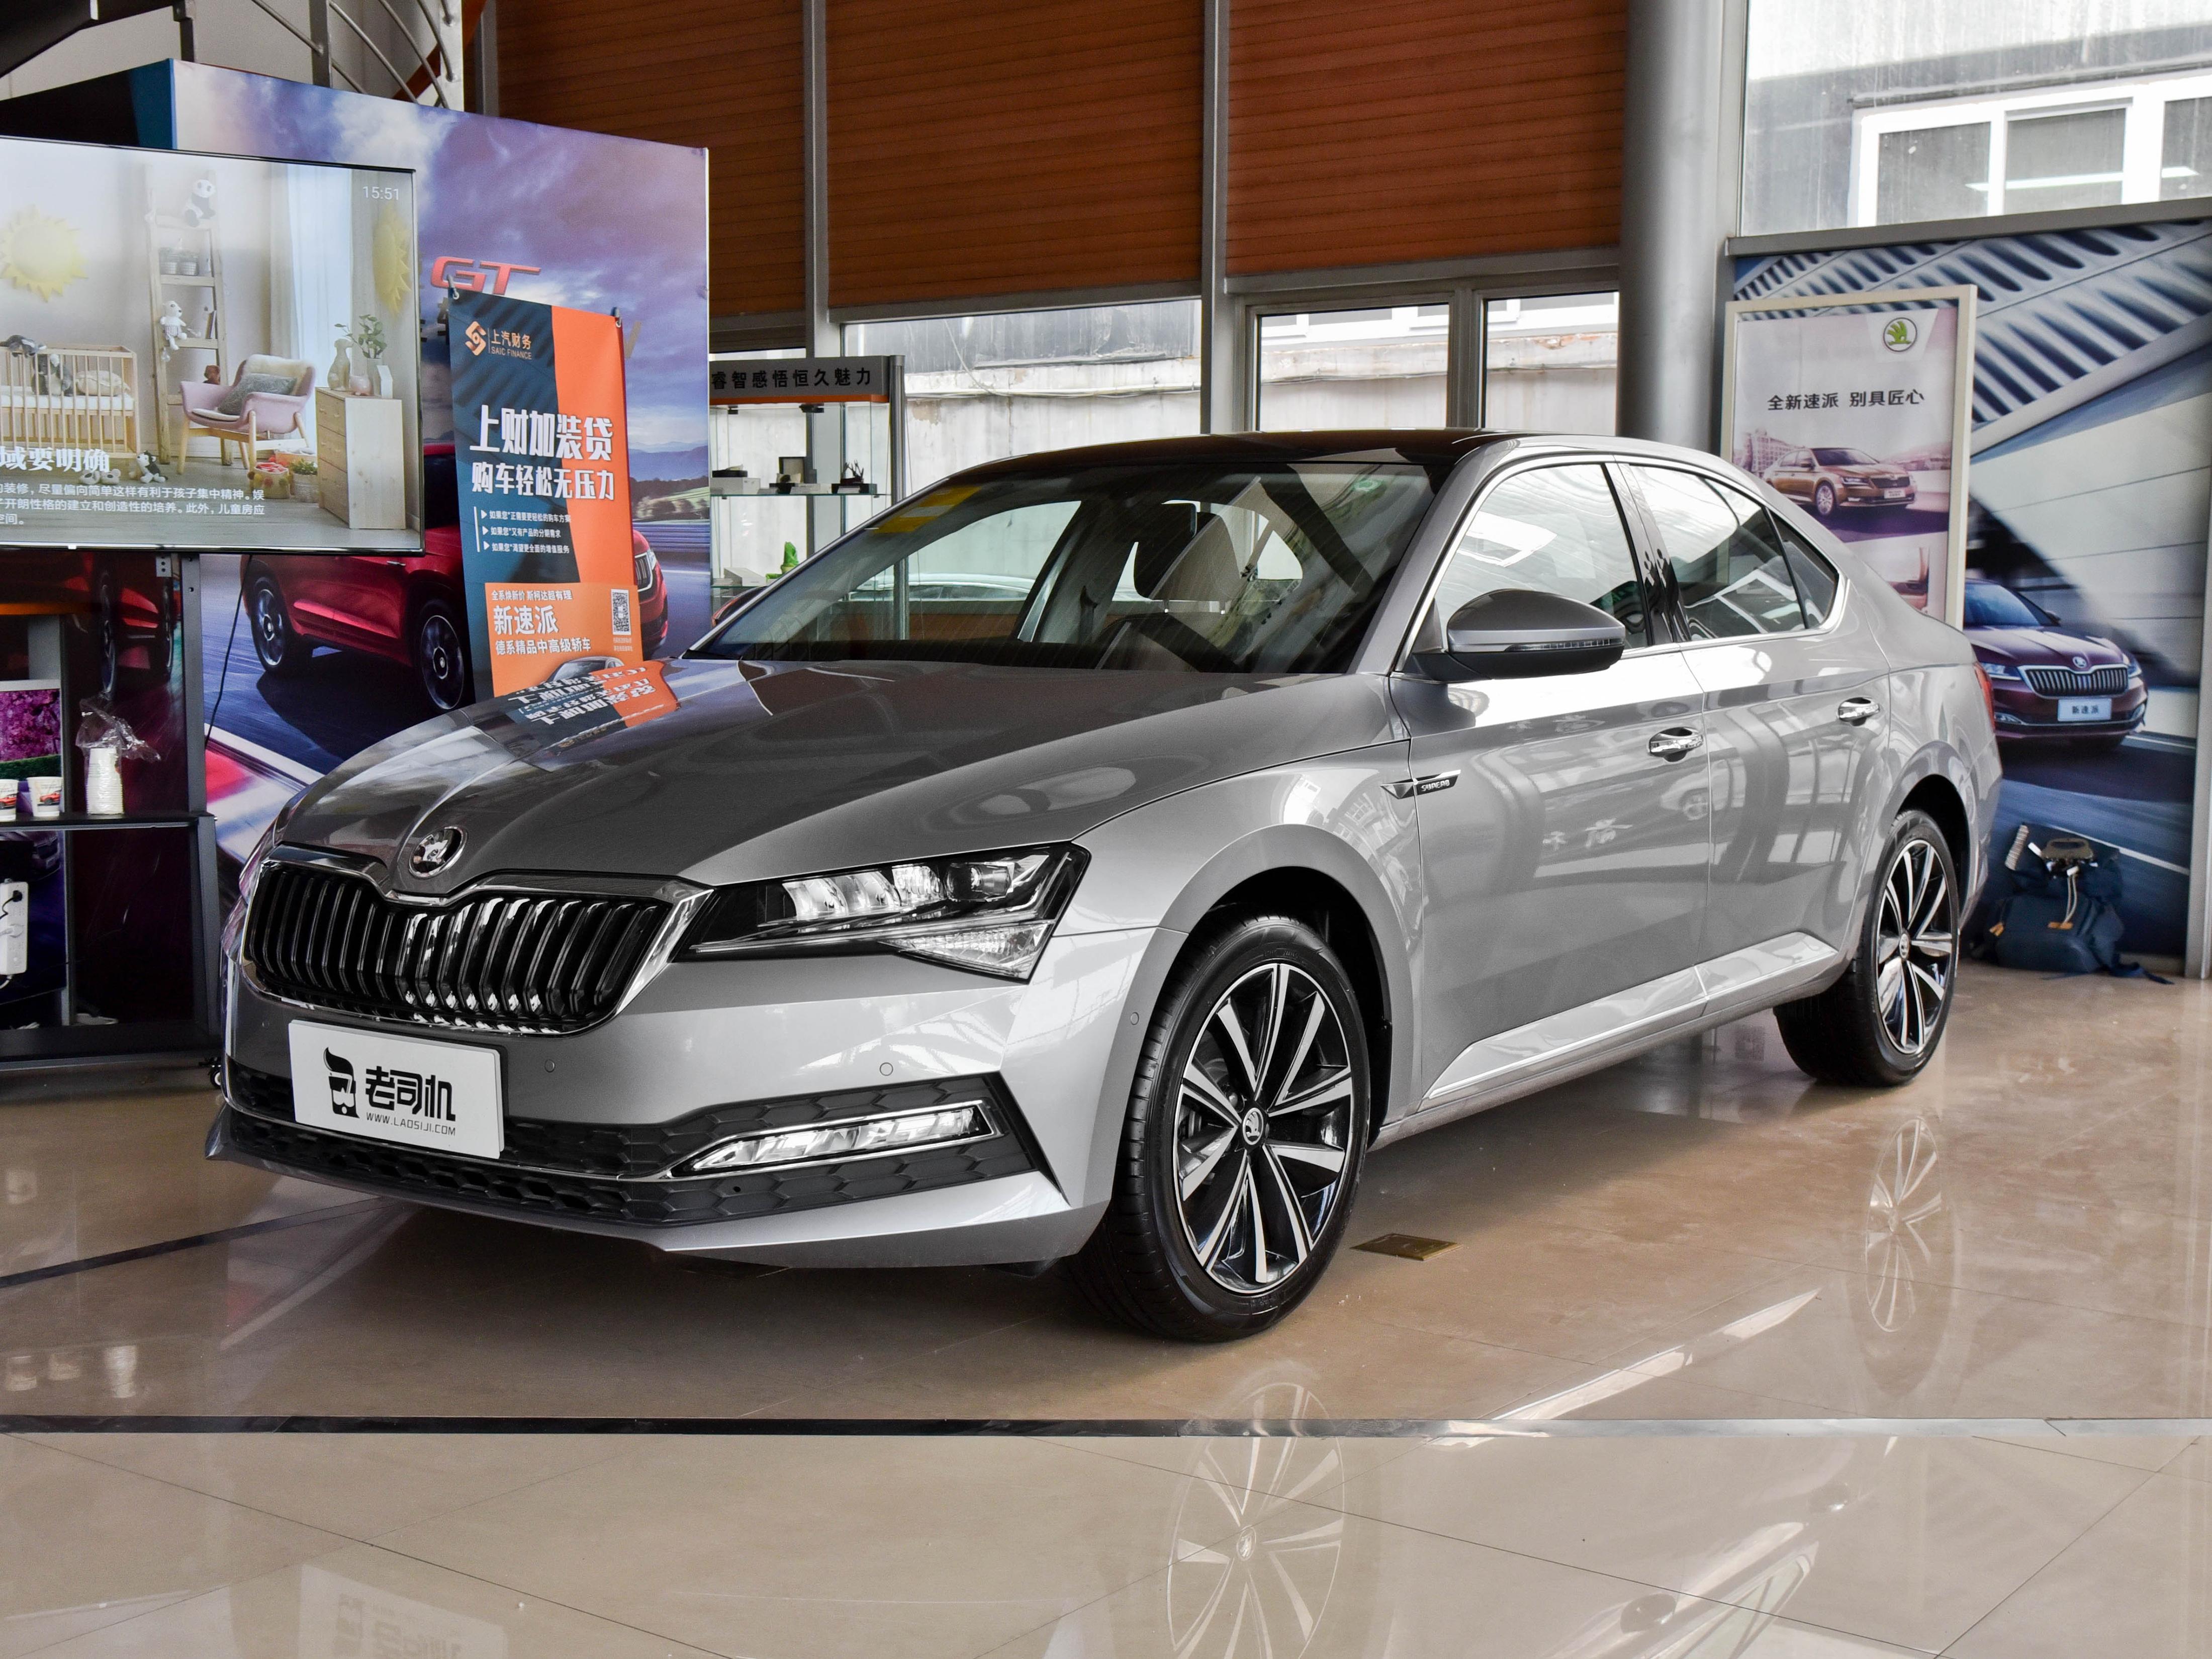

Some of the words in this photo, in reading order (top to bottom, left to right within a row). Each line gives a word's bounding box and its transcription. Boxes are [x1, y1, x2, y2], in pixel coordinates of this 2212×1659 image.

[363, 186, 399, 200] 15:51
[431, 256, 541, 296] GT
[491, 329, 531, 350] 上汽财务
[491, 346, 505, 356] SAIC
[507, 349, 532, 360] FINANCE
[712, 367, 871, 389] 睿智感悟恒久魅力
[1767, 393, 1838, 410] 全新速派
[1850, 389, 1924, 407] 别具匠心
[470, 405, 612, 460] 上财加装贷
[0, 446, 110, 473] 域要明确
[0, 483, 265, 501] 装修，尽量偏向简单这样有利于孩子集中精神。娱
[471, 461, 614, 500] 购车轻松无压力
[493, 604, 559, 635] 新速派
[495, 637, 591, 656] 德系精品中高级轿车
[365, 1065, 456, 1122] 老司机
[366, 1112, 456, 1136] WWW.LAOSIJI.COM
